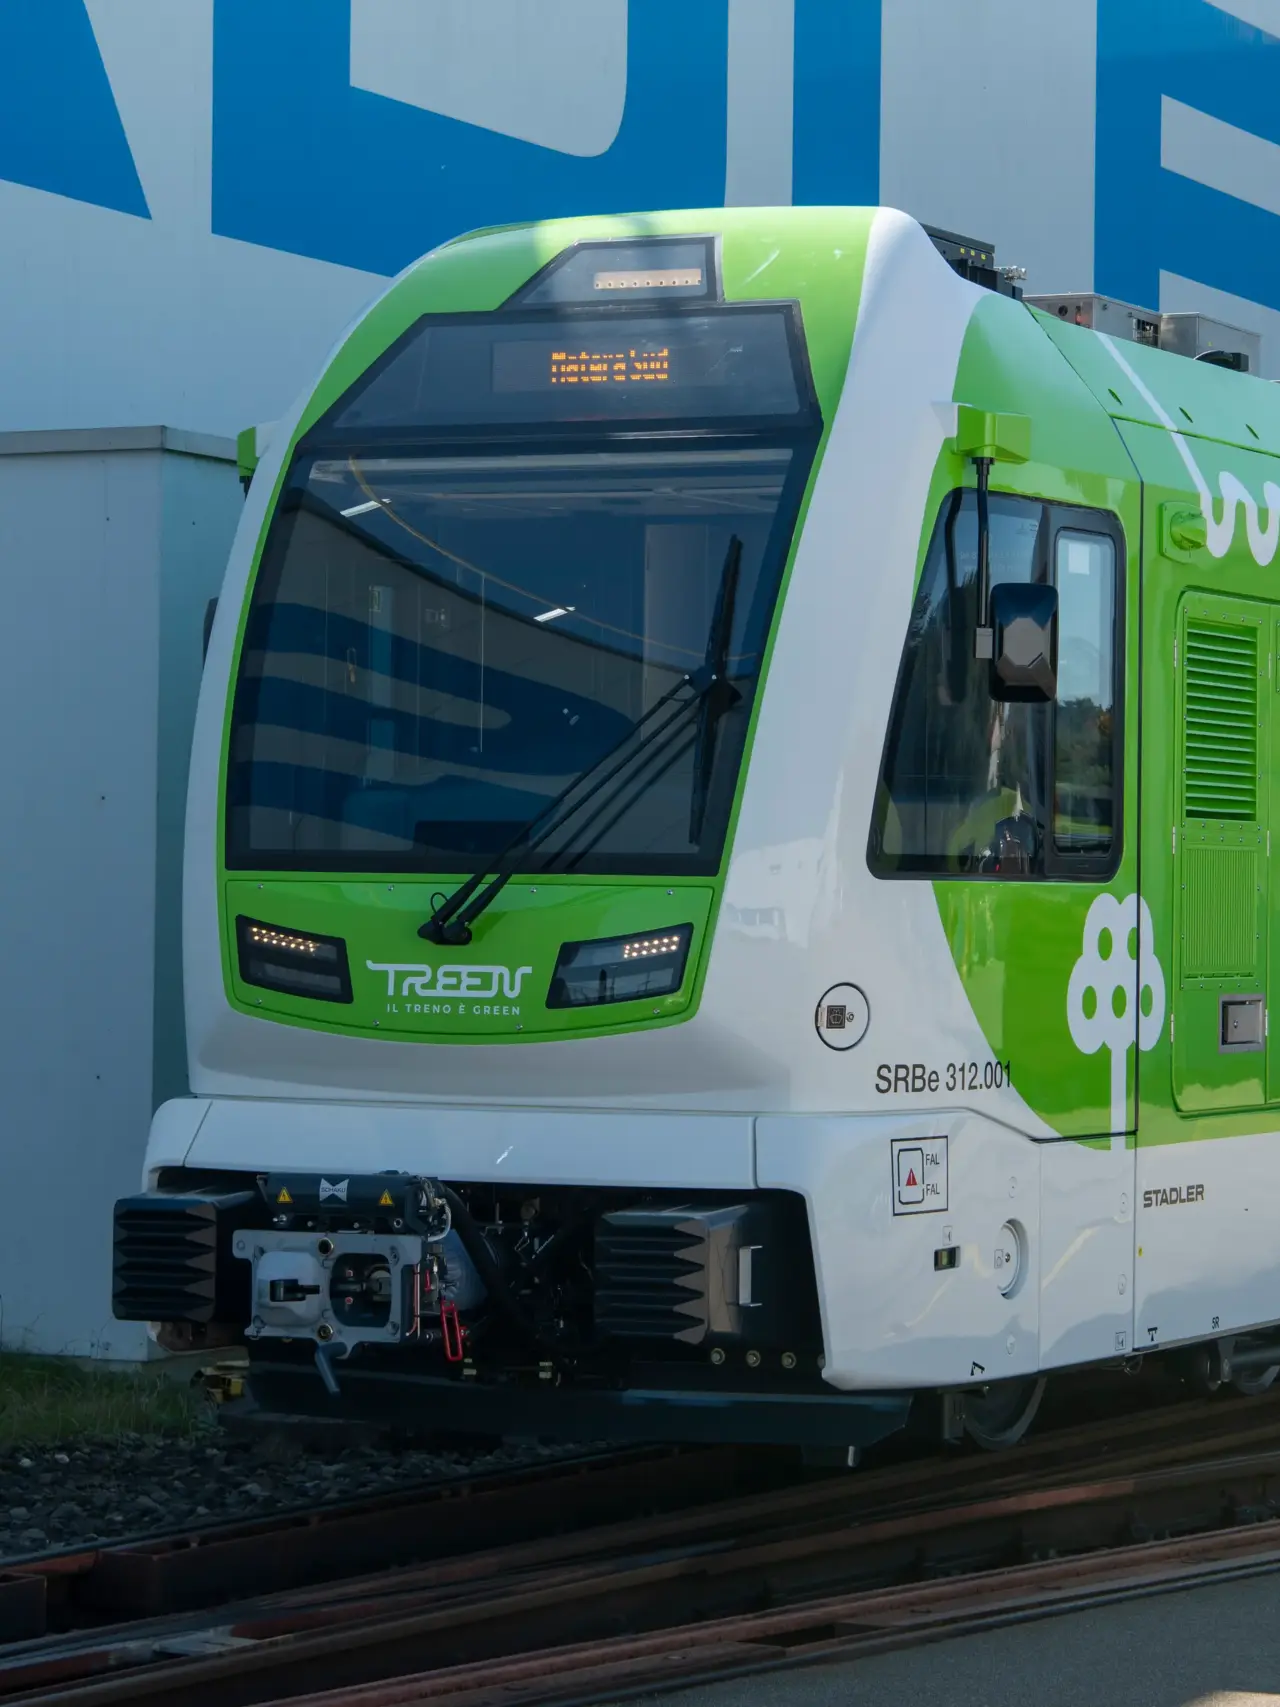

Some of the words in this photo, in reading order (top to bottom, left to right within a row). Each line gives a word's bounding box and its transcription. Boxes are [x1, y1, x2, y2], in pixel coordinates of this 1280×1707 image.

[366, 959, 533, 999] TREEN
[386, 1003, 399, 1014] IL
[405, 1004, 451, 1015] TRENO
[473, 1005, 521, 1016] GREEN
[875, 1063, 940, 1094] SRBe
[945, 1060, 1011, 1092] 312.001
[925, 1153, 940, 1166] FAL
[925, 1183, 940, 1196] FAL
[1143, 1183, 1205, 1209] STADLER
